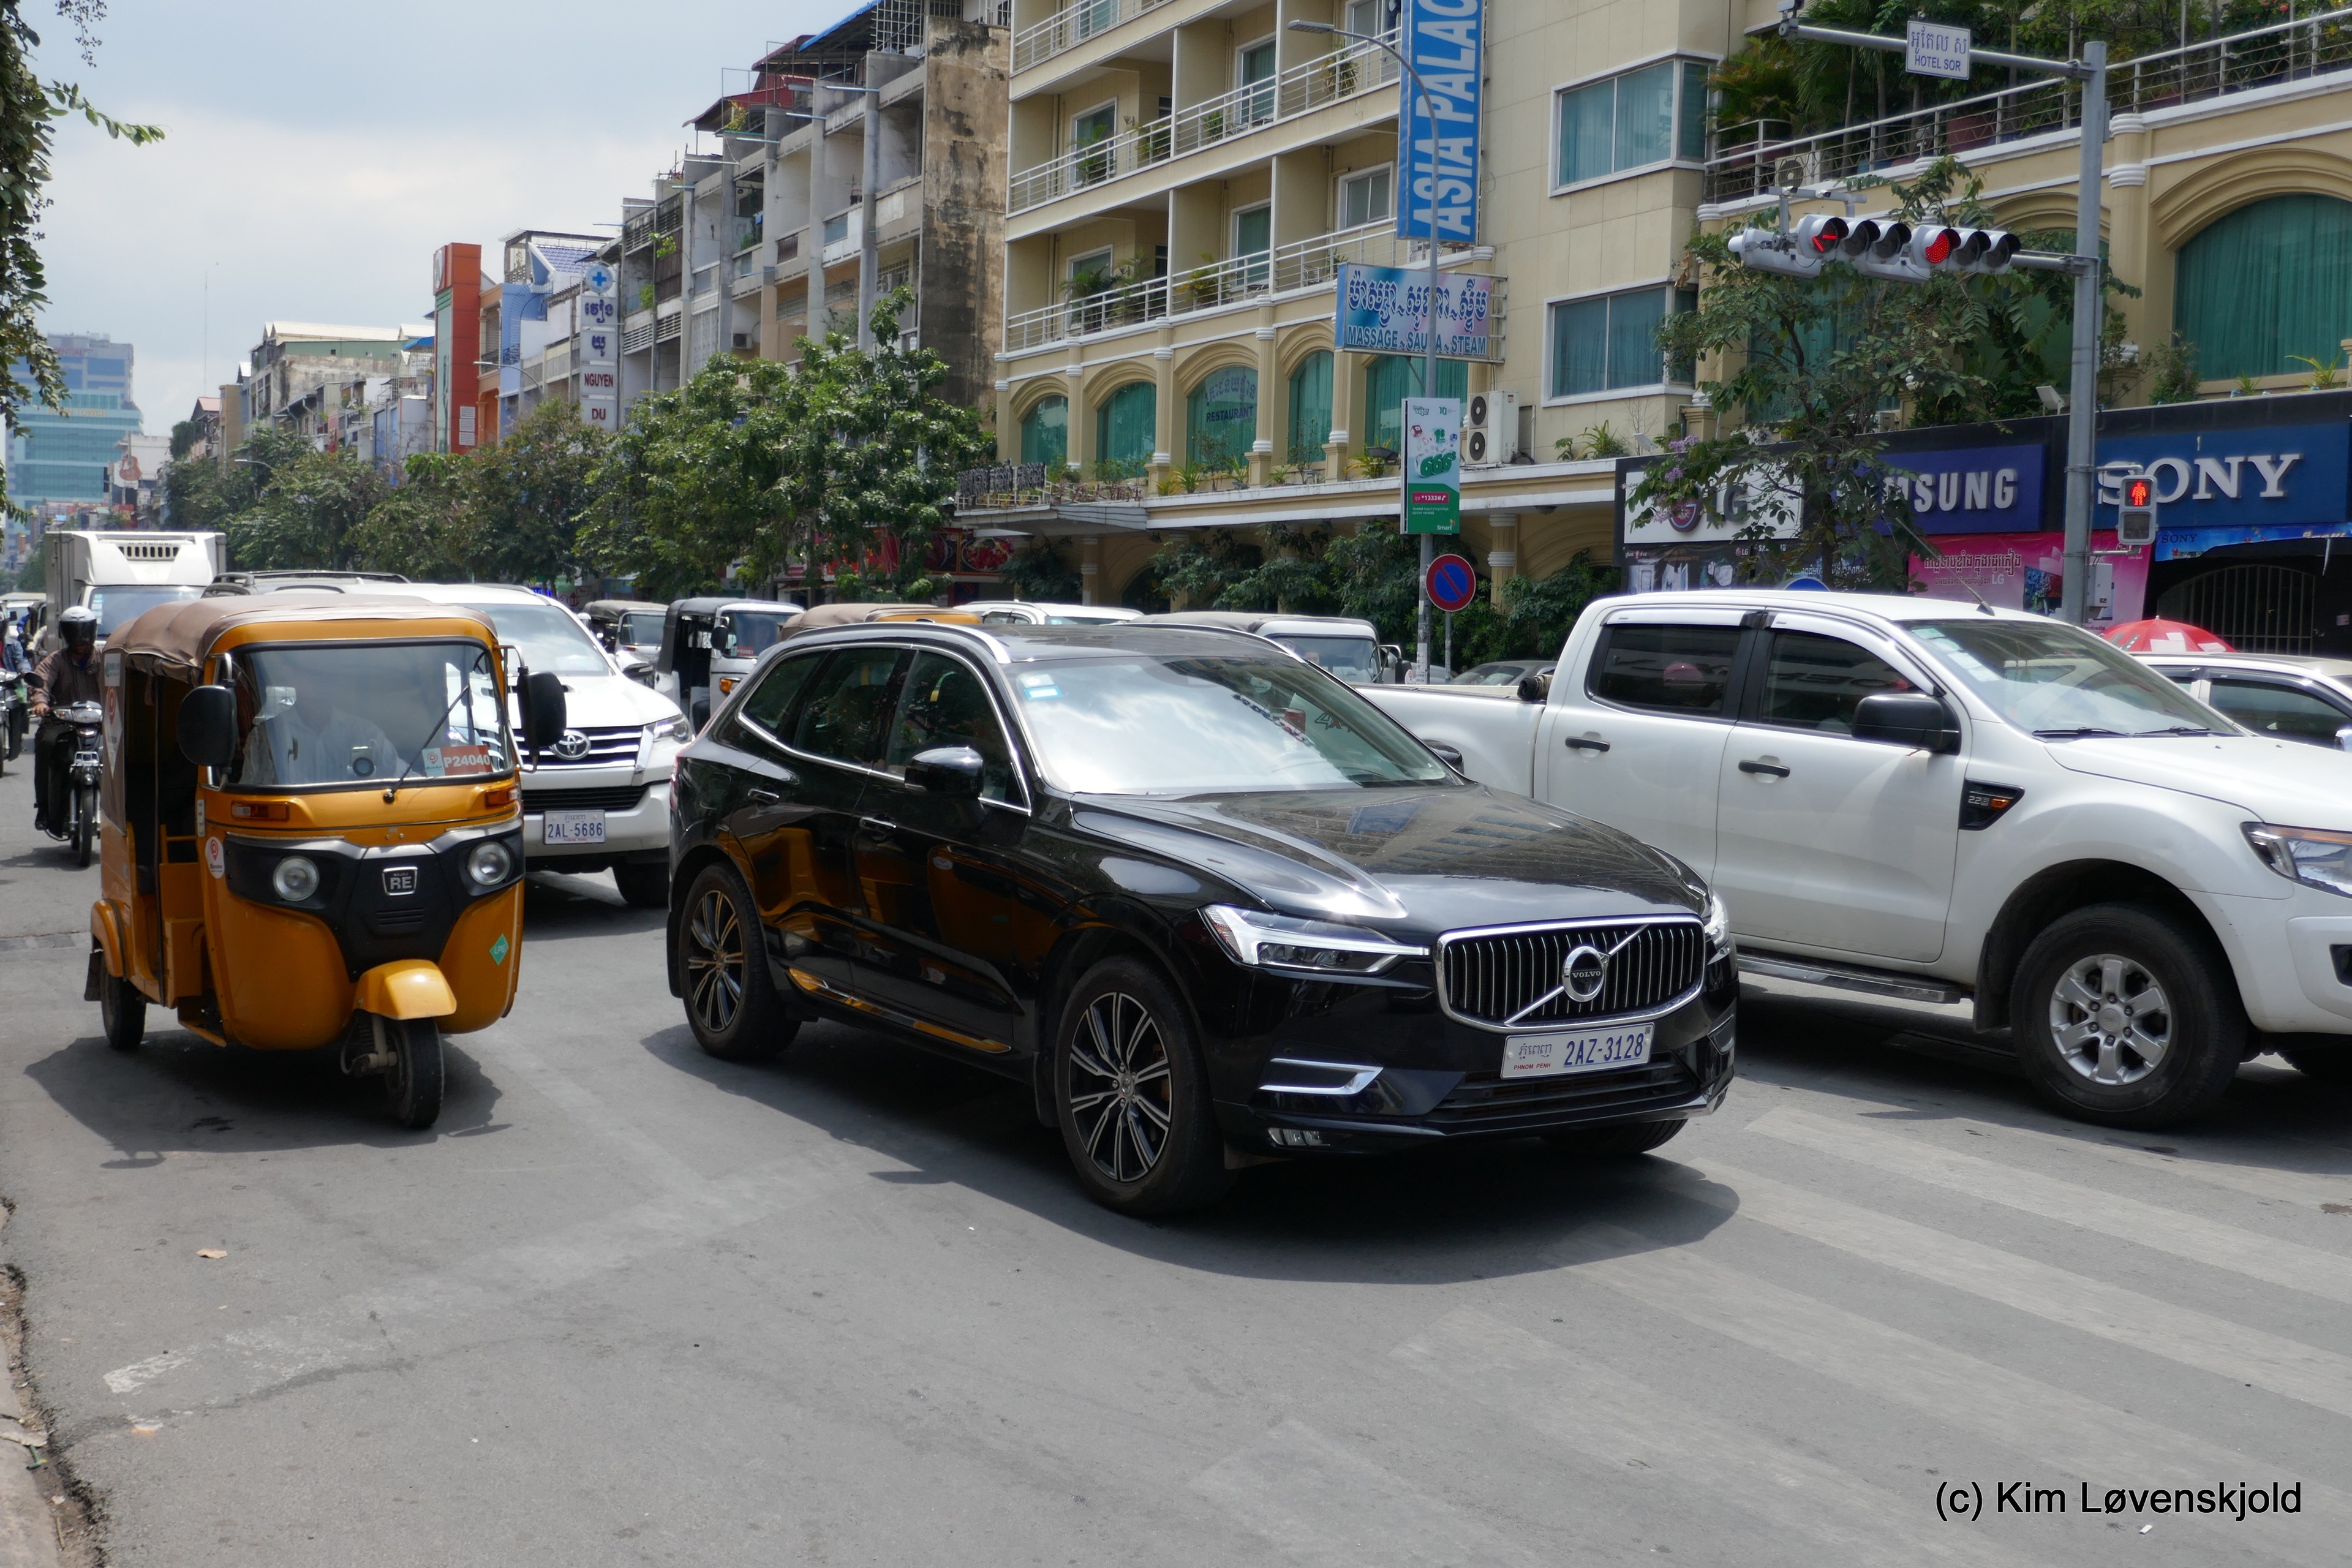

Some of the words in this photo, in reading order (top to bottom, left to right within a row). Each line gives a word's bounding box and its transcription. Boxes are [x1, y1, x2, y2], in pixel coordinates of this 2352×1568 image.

[1954, 37, 1967, 54] ស
[1915, 55, 1941, 69] HOTEL
[1943, 58, 1961, 72] SOR
[1413, 137, 1474, 236] ASIA
[1348, 326, 1398, 349] MASSAGE
[1407, 331, 1442, 353] SAUA
[1450, 334, 1487, 356] STEAM
[584, 372, 614, 388] NGUYEN
[77, 409, 108, 417] TOWER
[591, 408, 606, 421] DU
[1206, 405, 1254, 423] RESTAURANT
[2097, 453, 2304, 505] SONY
[2161, 533, 2198, 544] SONY
[1992, 574, 2005, 584] LG
[443, 754, 491, 768] P24040
[548, 823, 603, 838] 2AL-5686
[390, 876, 412, 890] RE
[1564, 1033, 1645, 1066] 2AZ-3128
